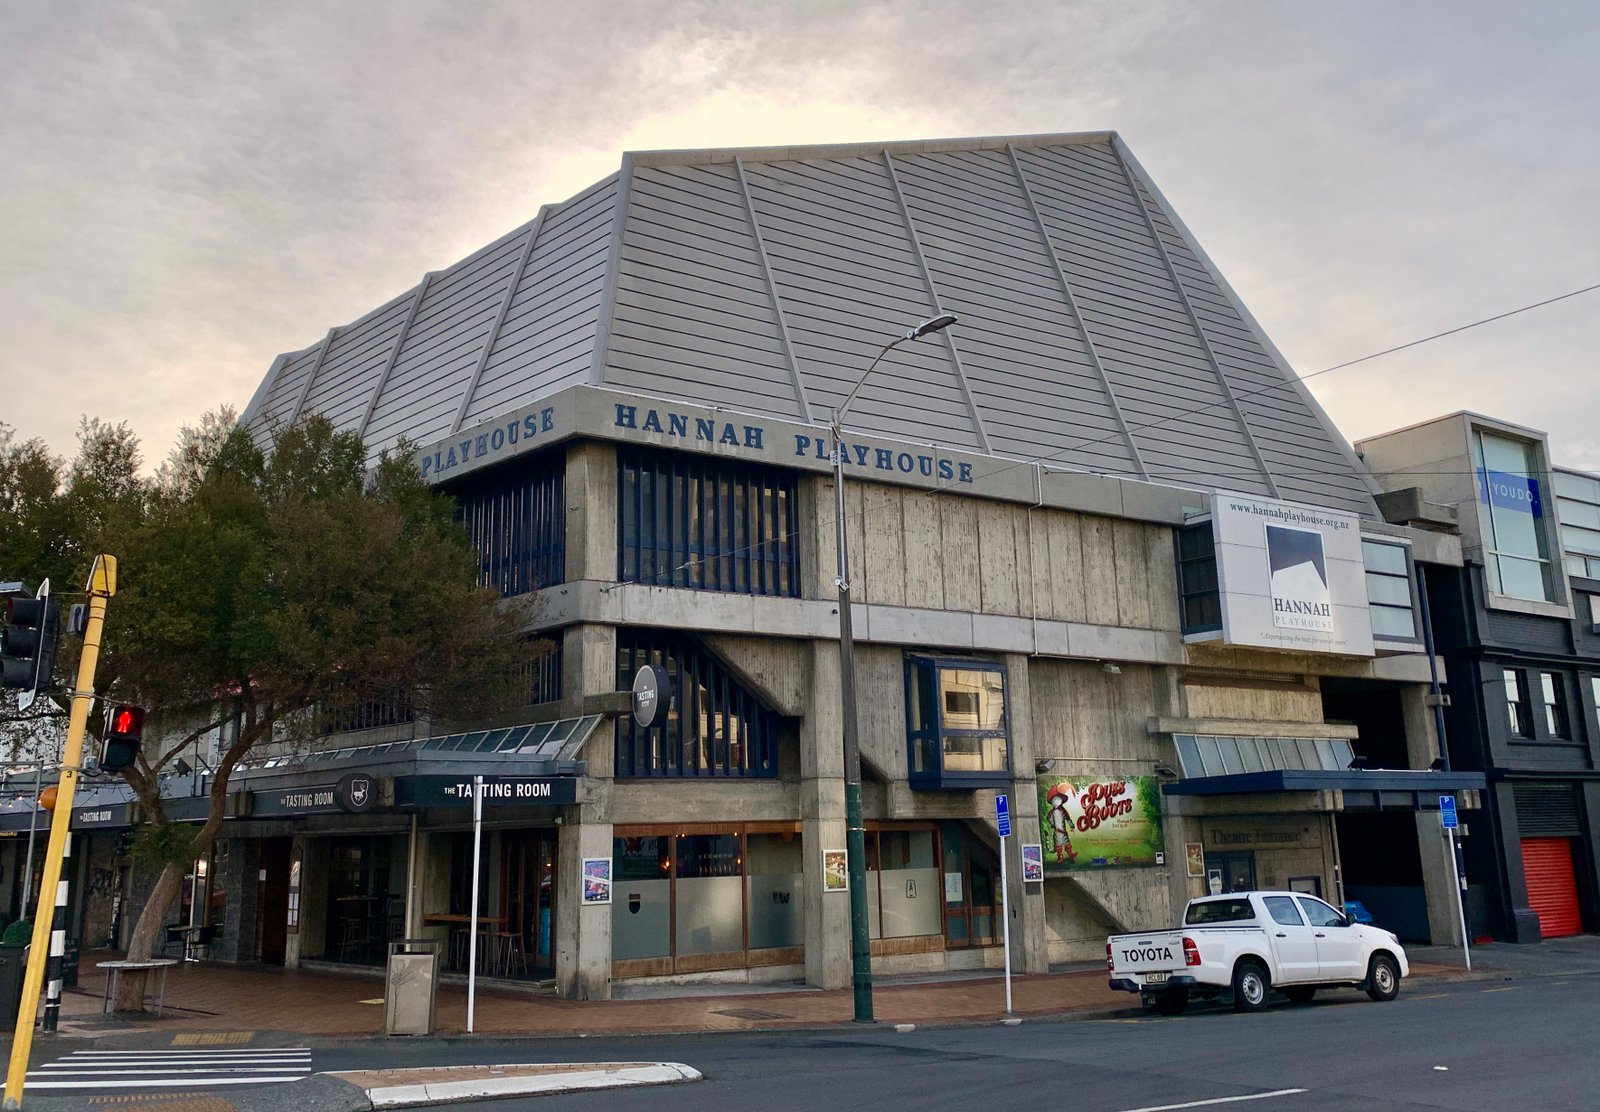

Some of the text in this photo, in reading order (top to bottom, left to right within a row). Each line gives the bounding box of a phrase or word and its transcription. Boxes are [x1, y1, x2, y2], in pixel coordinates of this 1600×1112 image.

[420, 406, 554, 478] PLAYHOUSE
[614, 403, 973, 484] HANNAH PLAYHOUSE
[1229, 502, 1350, 531] www.hannahplayhouse.org.nz
[1273, 598, 1331, 617] HANNAH
[66, 770, 73, 778] 3
[444, 783, 551, 798] THE TATING ROOM
[286, 793, 312, 807] TASTING
[314, 791, 334, 806] ROOM
[999, 797, 1004, 805] P
[1444, 796, 1450, 804] P
[1121, 947, 1173, 963] TOYOTA
